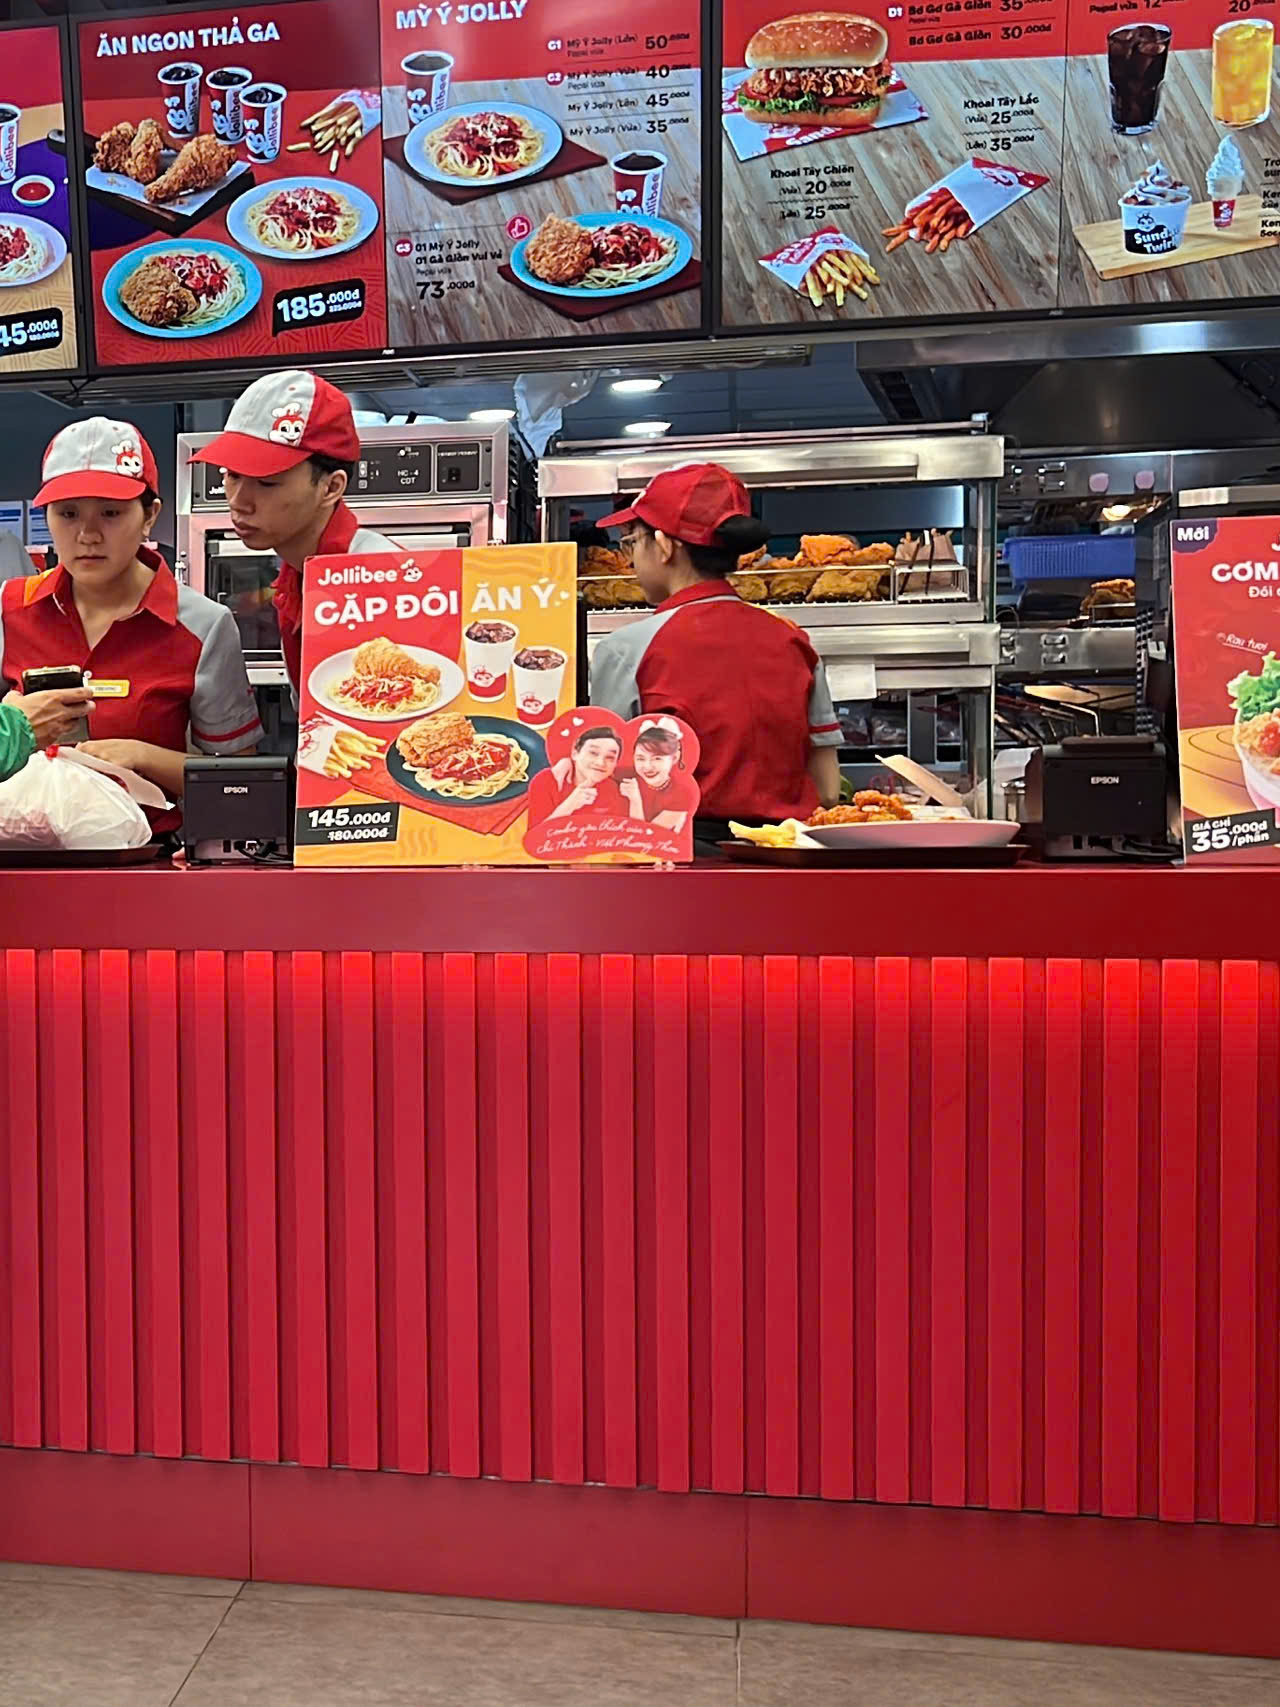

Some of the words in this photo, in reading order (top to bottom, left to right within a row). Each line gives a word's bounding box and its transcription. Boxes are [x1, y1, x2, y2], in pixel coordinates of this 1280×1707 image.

[396, 3, 433, 30] MỲ
[435, 1, 453, 25] Ý
[455, 0, 528, 24] JOLLY
[96, 32, 127, 58] ĂN
[131, 33, 195, 55] NGON
[198, 17, 244, 47] THẢ
[247, 22, 280, 43] GA
[963, 97, 995, 109] Khoai
[997, 96, 1017, 108] Tây
[770, 167, 800, 179] Khoai
[415, 256, 427, 265] 01
[1176, 526, 1210, 542] Mới
[317, 568, 399, 587] Jollibee
[1211, 560, 1279, 583] CƠM
[314, 593, 389, 631] CẶP
[394, 585, 459, 620] ĐÔI
[470, 581, 522, 613] ĂN
[530, 577, 558, 609] Ý
[1225, 633, 1245, 647] Rau
[1090, 775, 1120, 785] EPSON
[223, 786, 249, 794] EPSON
[307, 807, 392, 828] 145.000đ
[1191, 820, 1211, 832] GIÁ
[326, 827, 390, 841] 180.000đ
